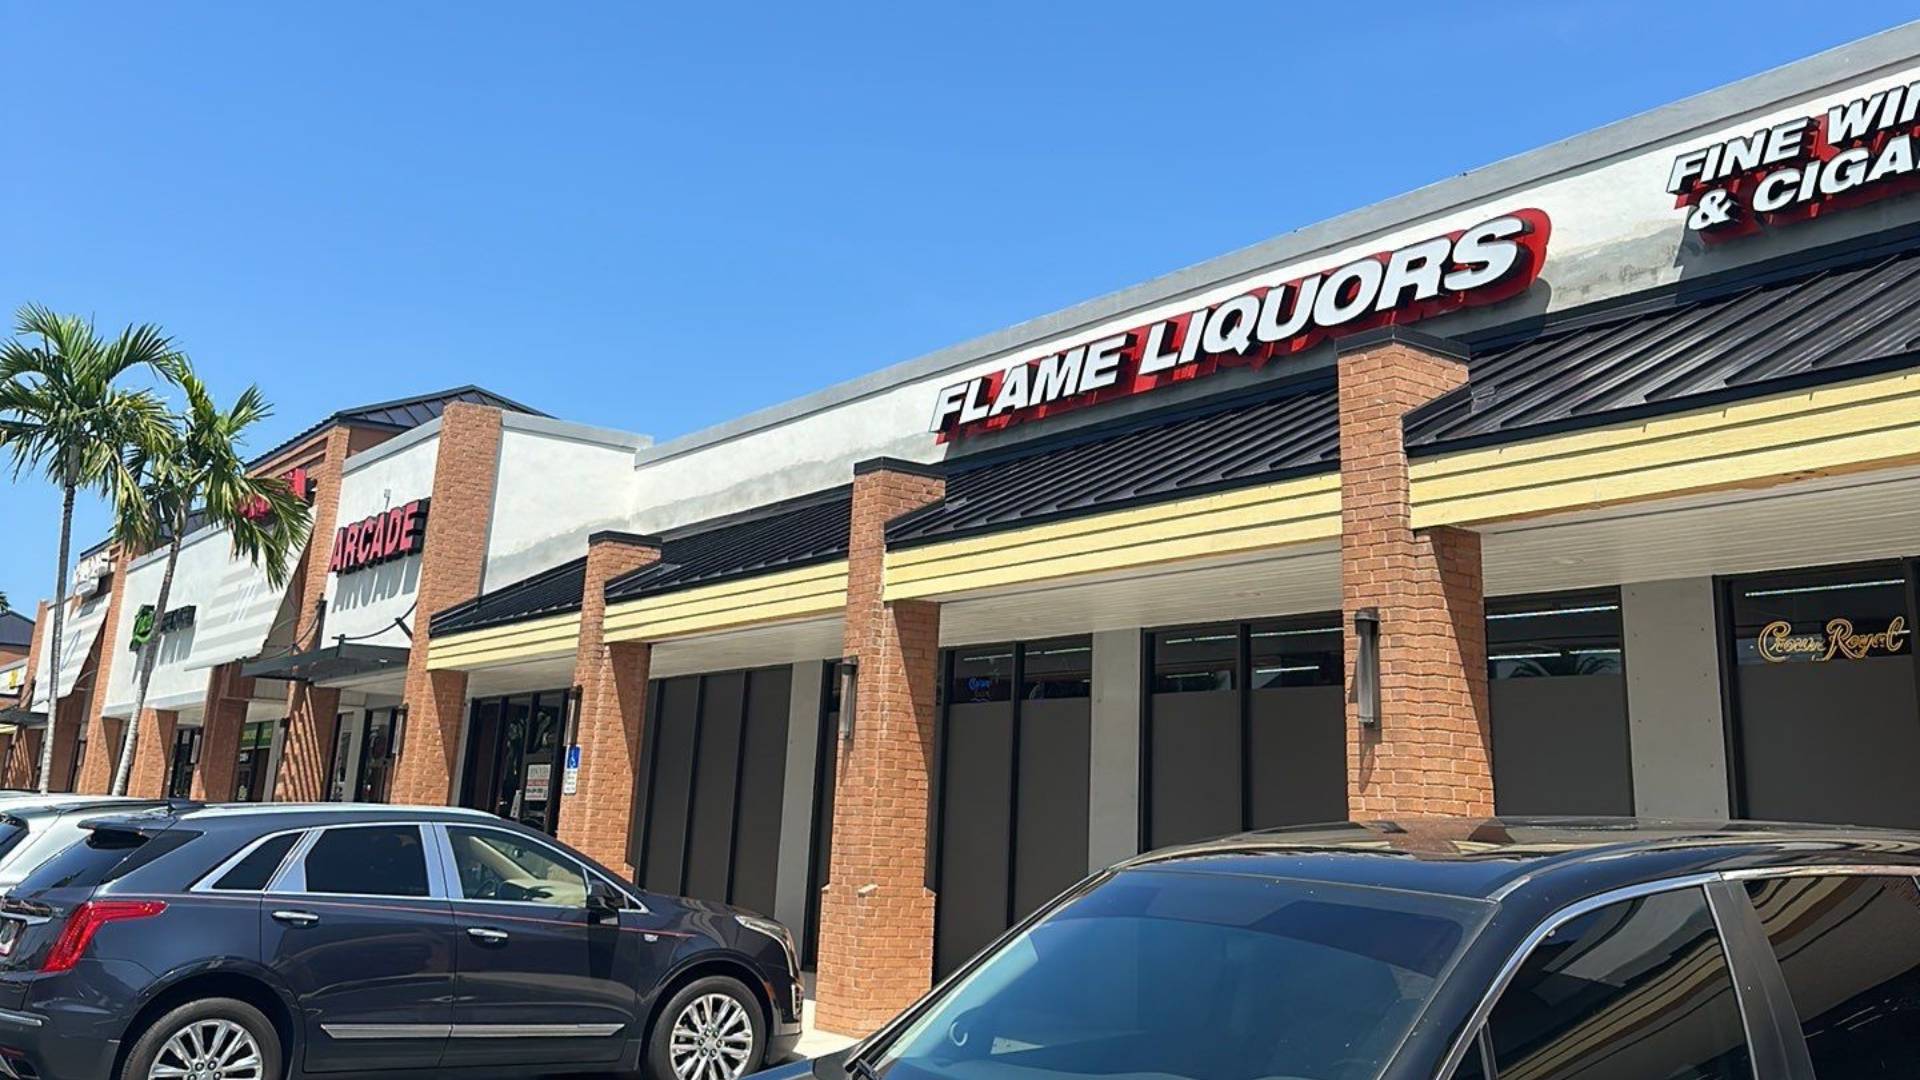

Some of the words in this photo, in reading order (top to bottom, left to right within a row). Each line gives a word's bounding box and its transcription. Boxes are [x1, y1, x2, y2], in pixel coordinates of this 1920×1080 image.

[1667, 117, 1809, 193] FINE
[1688, 188, 1735, 231] &
[1752, 134, 1920, 213] CIGA
[930, 333, 1130, 433] FLAME
[1139, 214, 1527, 374] LIQUORS
[329, 499, 421, 574] ARCADE
[1758, 621, 1826, 662] Crown
